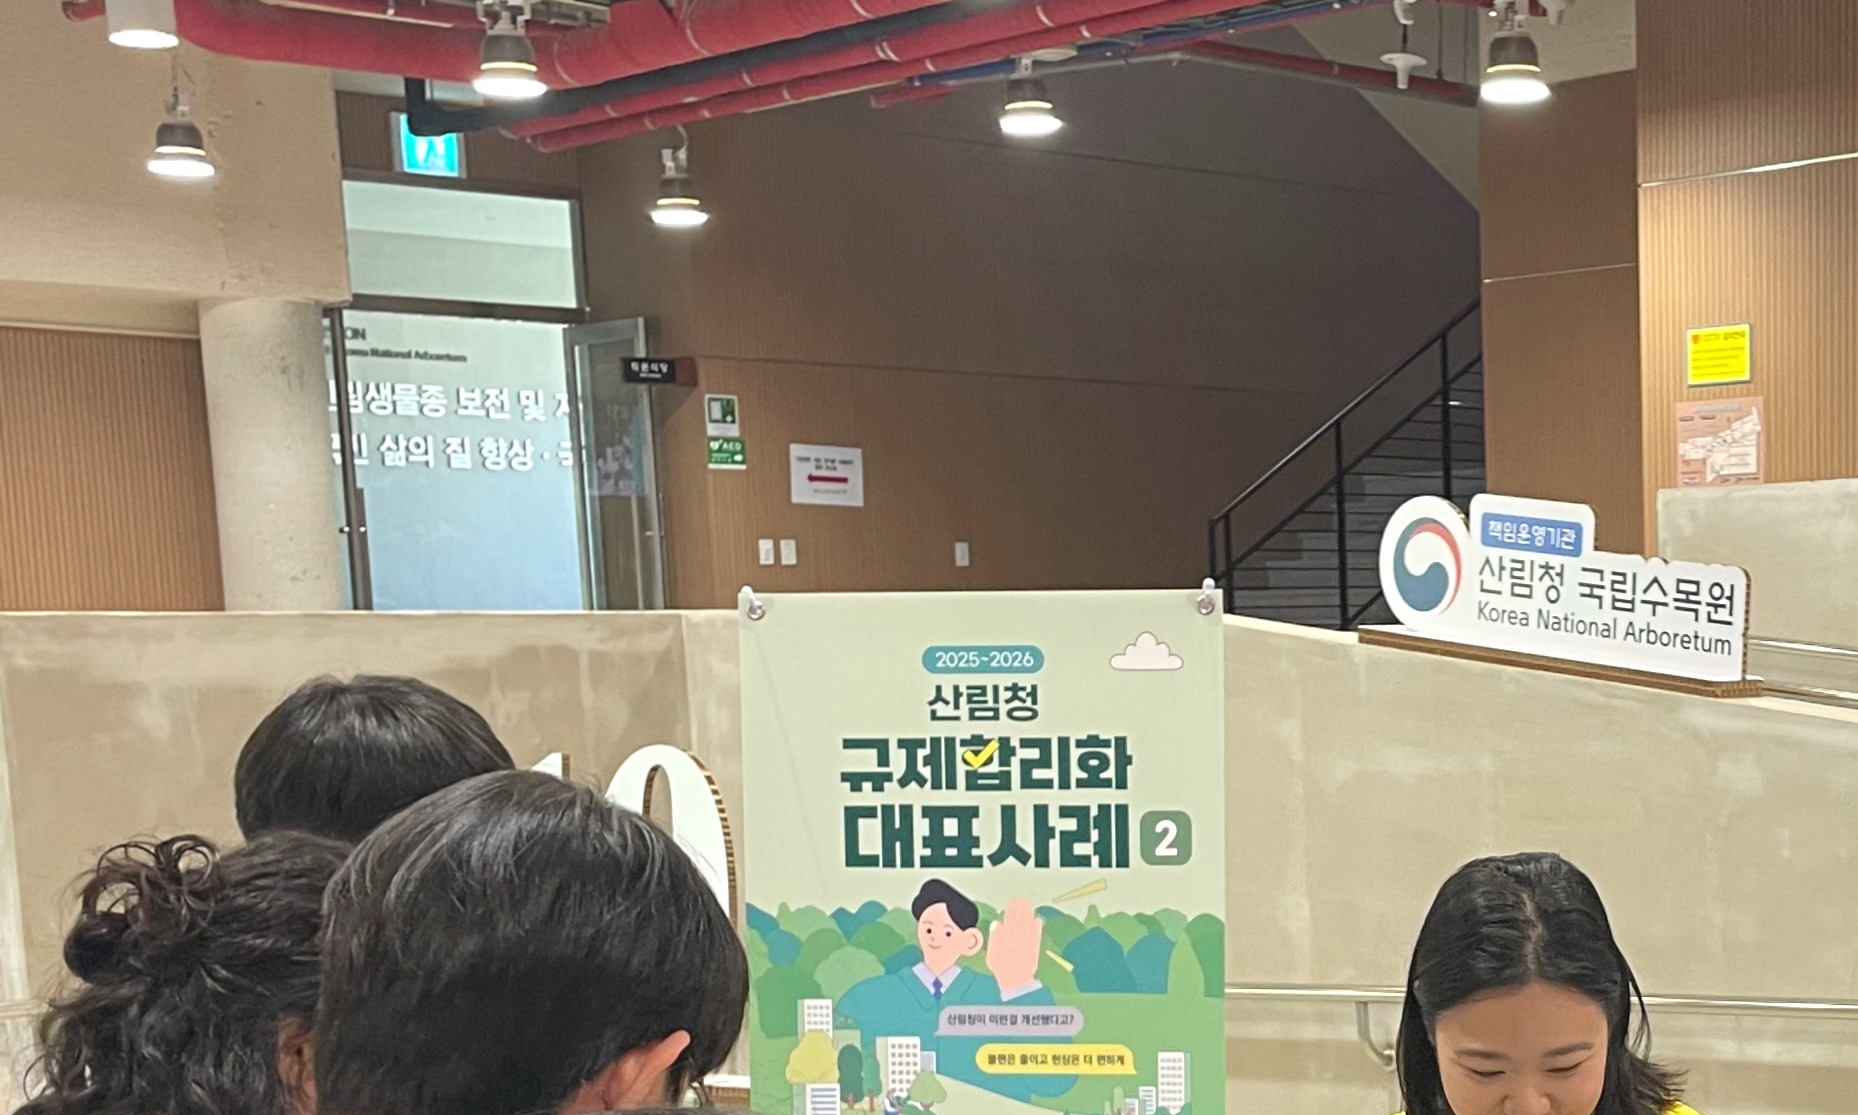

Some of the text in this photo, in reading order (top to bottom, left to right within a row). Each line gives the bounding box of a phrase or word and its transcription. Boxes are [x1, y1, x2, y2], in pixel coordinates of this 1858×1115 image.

[456, 387, 511, 420] 보전
[518, 389, 547, 422] 및
[379, 434, 435, 469] 삶의
[445, 436, 473, 470] 질
[479, 437, 535, 471] 향상
[721, 441, 743, 452] AED
[1487, 520, 1577, 551] 책임운영기관
[1478, 555, 1736, 626] 산림청 국립수목원
[1476, 600, 1733, 656] Korea National Arboretum
[935, 651, 1035, 668] 2025~2026
[927, 682, 1040, 722] 산림청
[840, 733, 1133, 793] 규제합리화
[842, 803, 1179, 869] 대표사례 2
[947, 1013, 987, 1026] 산림청이
[1083, 1054, 1093, 1066] 더
[1096, 1053, 1126, 1066] 편하게
